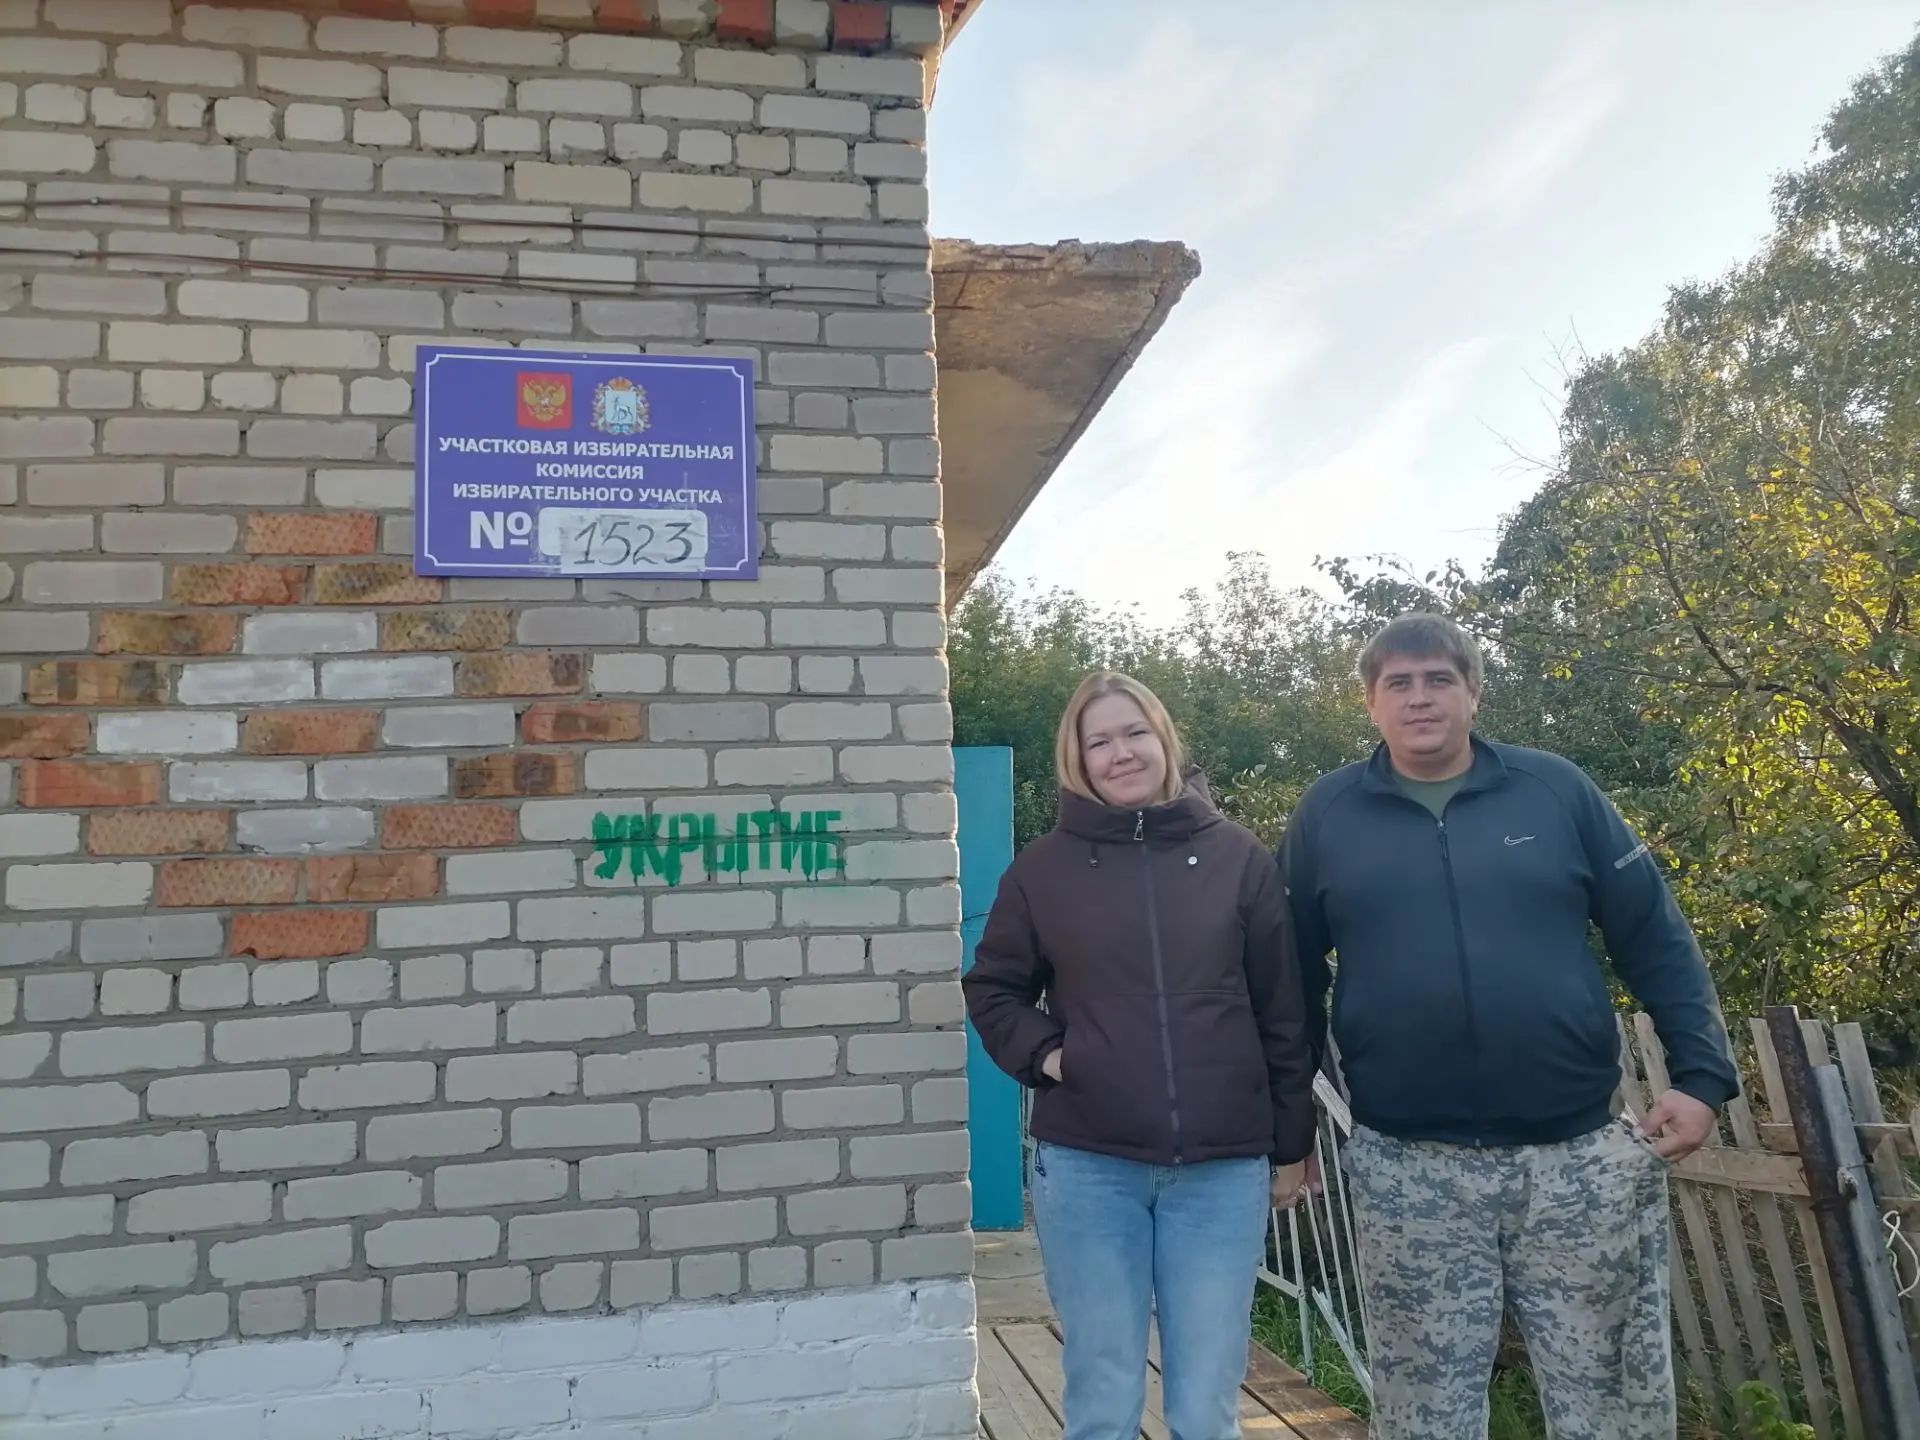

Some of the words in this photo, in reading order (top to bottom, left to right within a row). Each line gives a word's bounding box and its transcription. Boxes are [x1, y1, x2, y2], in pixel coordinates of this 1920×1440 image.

[439, 437, 568, 456] УЧАСТКОВАЯ
[574, 441, 734, 460] ИЗБИРАТЕЛЬНАЯ
[536, 463, 644, 480] КОМИССИЯ
[453, 483, 634, 503] ИЗБИРАТЕЛЬНОГО
[639, 487, 723, 504] УЧАСТКА
[573, 522, 693, 566] 1523
[592, 811, 844, 887] УКРЫТИЕ
